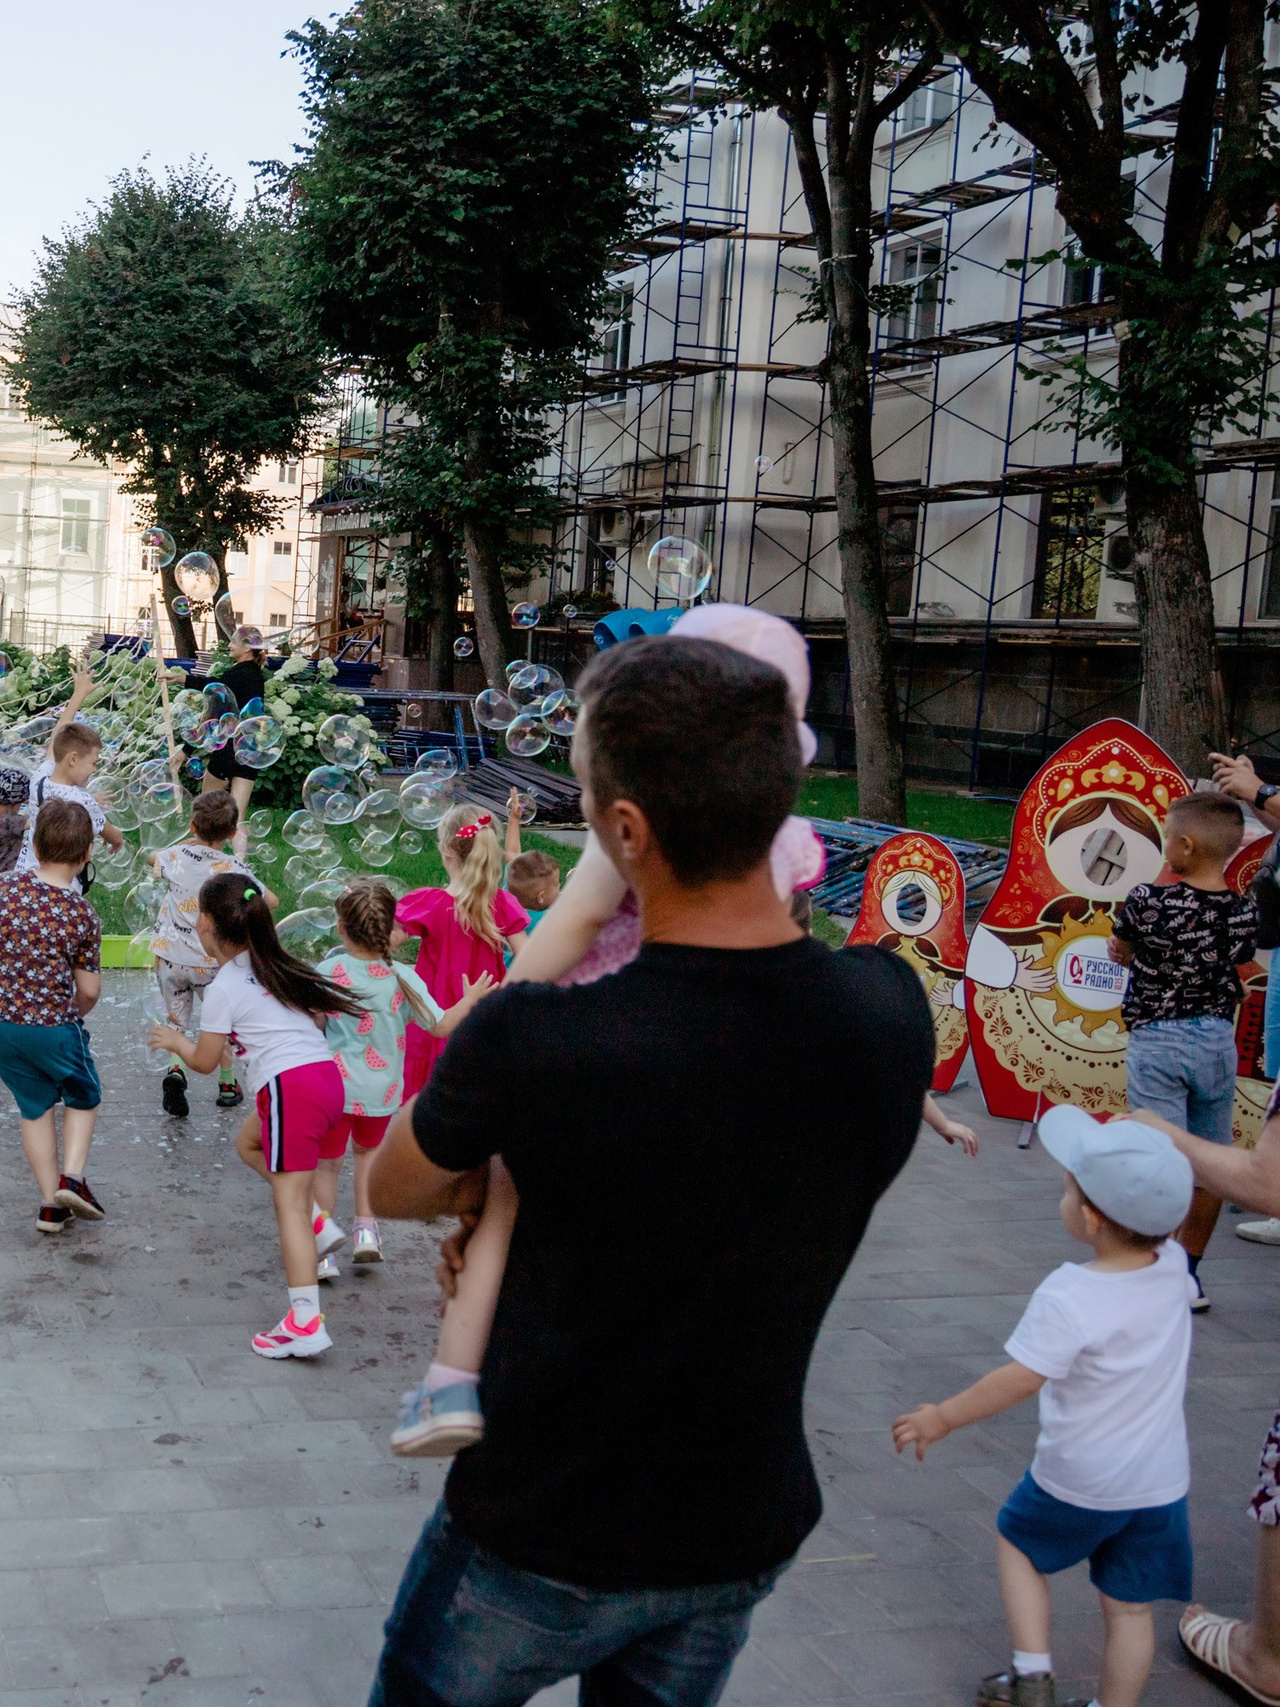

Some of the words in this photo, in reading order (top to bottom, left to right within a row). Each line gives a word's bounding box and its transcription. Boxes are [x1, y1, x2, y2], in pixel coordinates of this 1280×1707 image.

[1164, 898, 1200, 910] ONLINE
[1177, 929, 1211, 941] OFFLINE
[1086, 960, 1125, 978] РУССКОЕ
[1084, 973, 1114, 990] РАДИО
